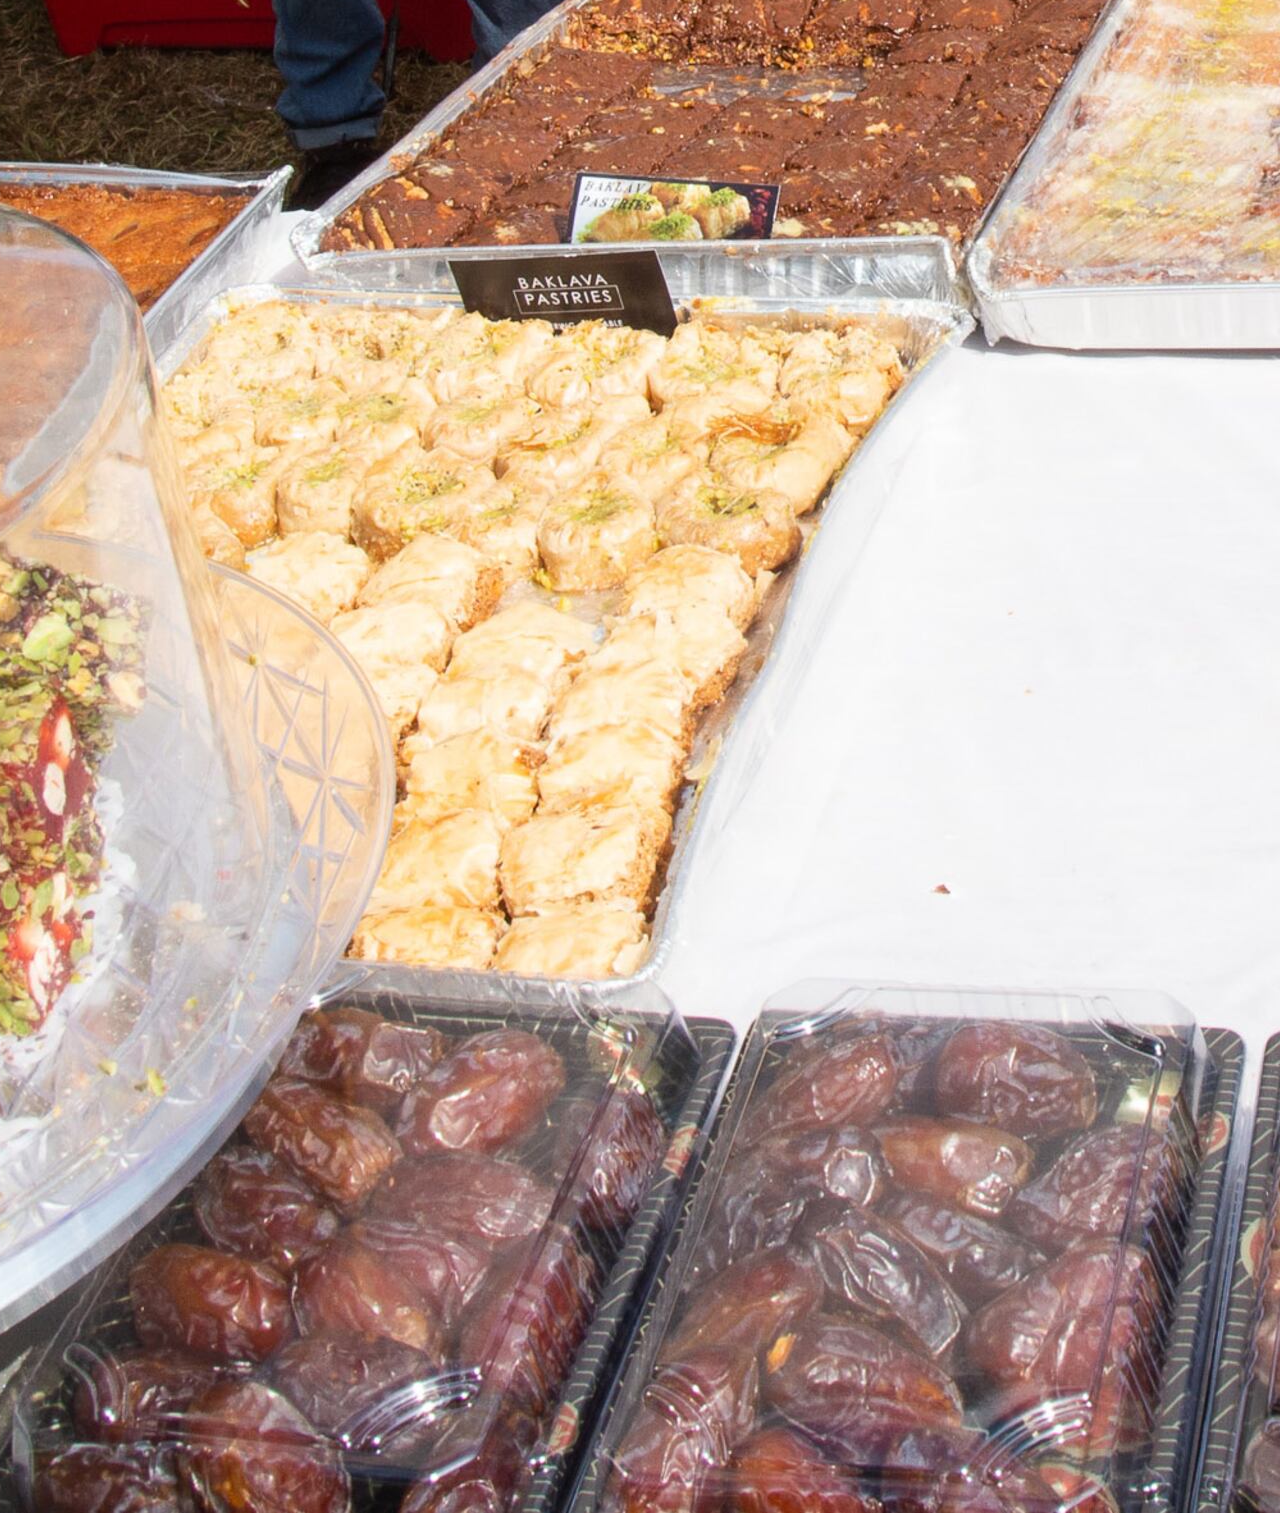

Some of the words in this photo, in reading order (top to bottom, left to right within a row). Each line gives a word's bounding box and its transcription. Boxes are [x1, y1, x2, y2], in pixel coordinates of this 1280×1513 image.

[579, 195, 656, 212] PASTRIES
[517, 273, 608, 290] BAKLAVA
[524, 289, 613, 307] PASTRIES
